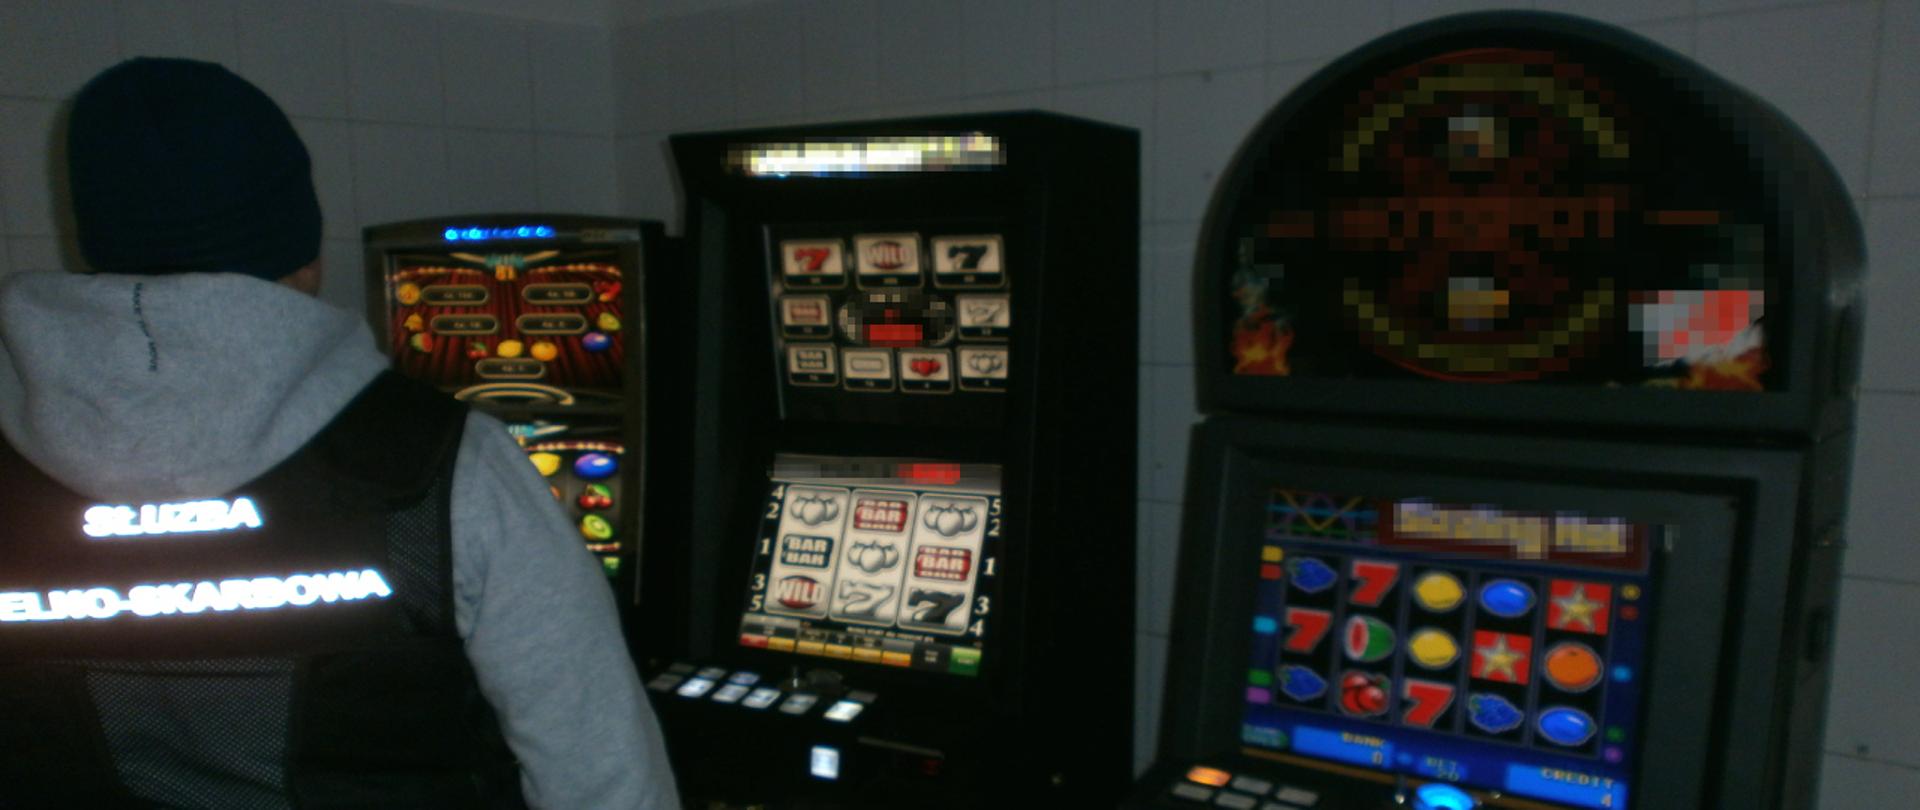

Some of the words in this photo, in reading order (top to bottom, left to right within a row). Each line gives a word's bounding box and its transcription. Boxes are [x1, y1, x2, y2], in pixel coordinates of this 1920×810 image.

[771, 484, 785, 500] 4
[766, 502, 779, 519] 2
[860, 507, 902, 523] BAR
[988, 519, 1001, 538] 2
[760, 539, 771, 555] 1
[788, 536, 828, 552] BAR
[921, 556, 965, 572] BAR
[984, 558, 996, 575] 1
[752, 574, 765, 591] 3
[748, 595, 763, 612] 5
[974, 596, 990, 615] 3
[969, 620, 985, 637] 4
